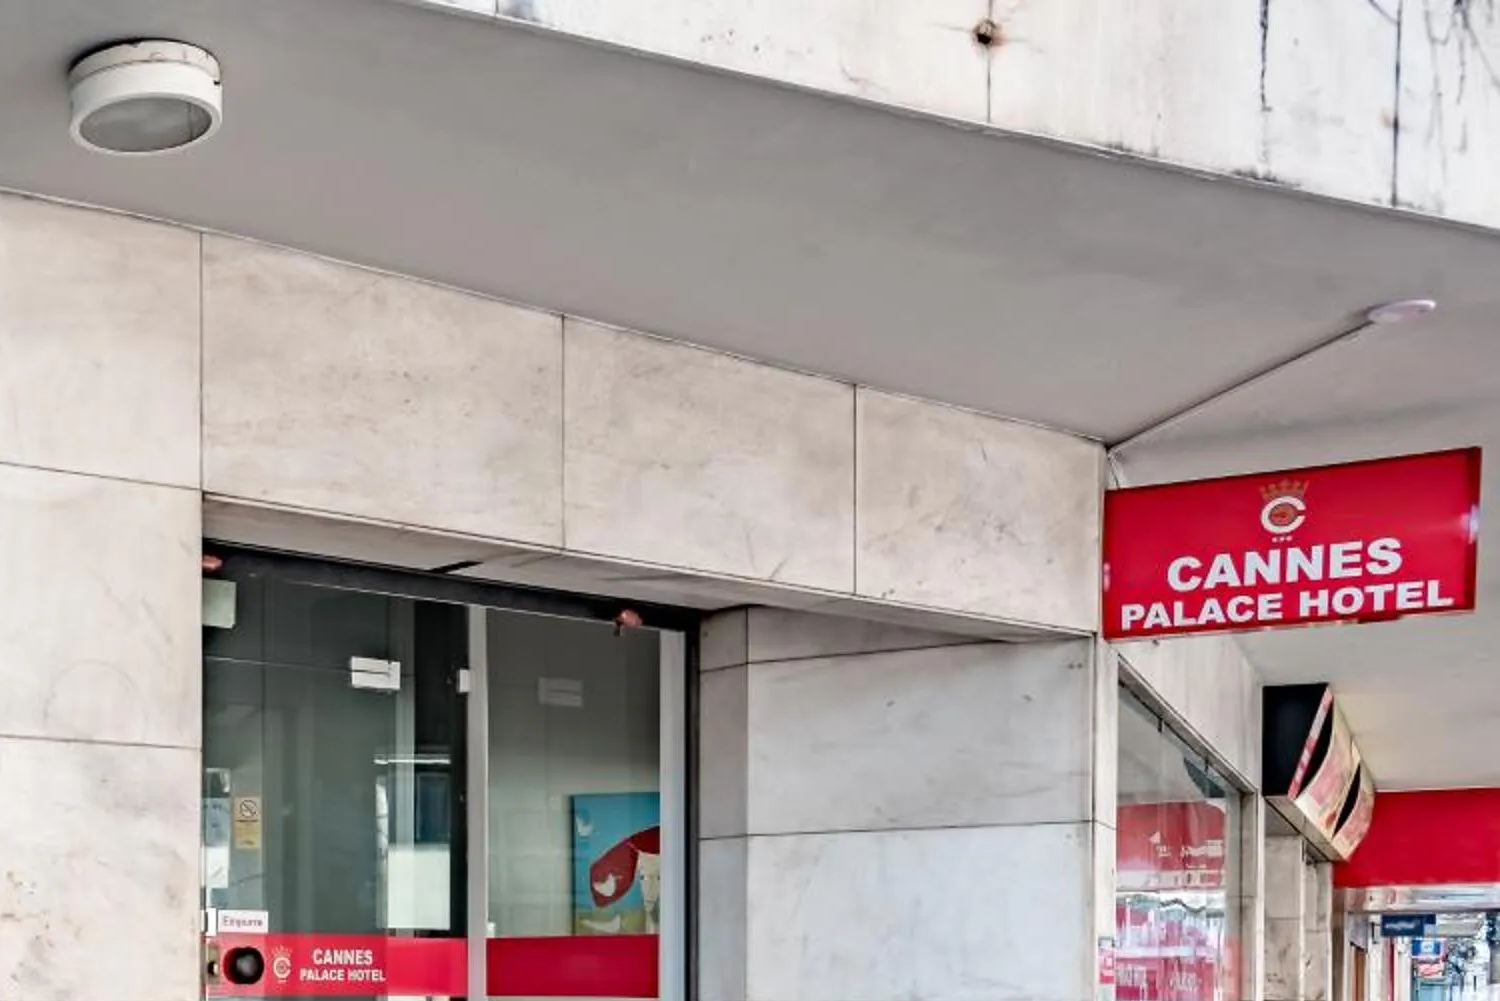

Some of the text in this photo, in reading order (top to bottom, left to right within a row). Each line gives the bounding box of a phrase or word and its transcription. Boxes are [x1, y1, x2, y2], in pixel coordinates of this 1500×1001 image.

[1167, 537, 1402, 592] CANNES
[1121, 580, 1454, 631] PALACE HOTEL
[313, 948, 373, 965] CANNES
[299, 968, 387, 982] PALACE HOTEL
